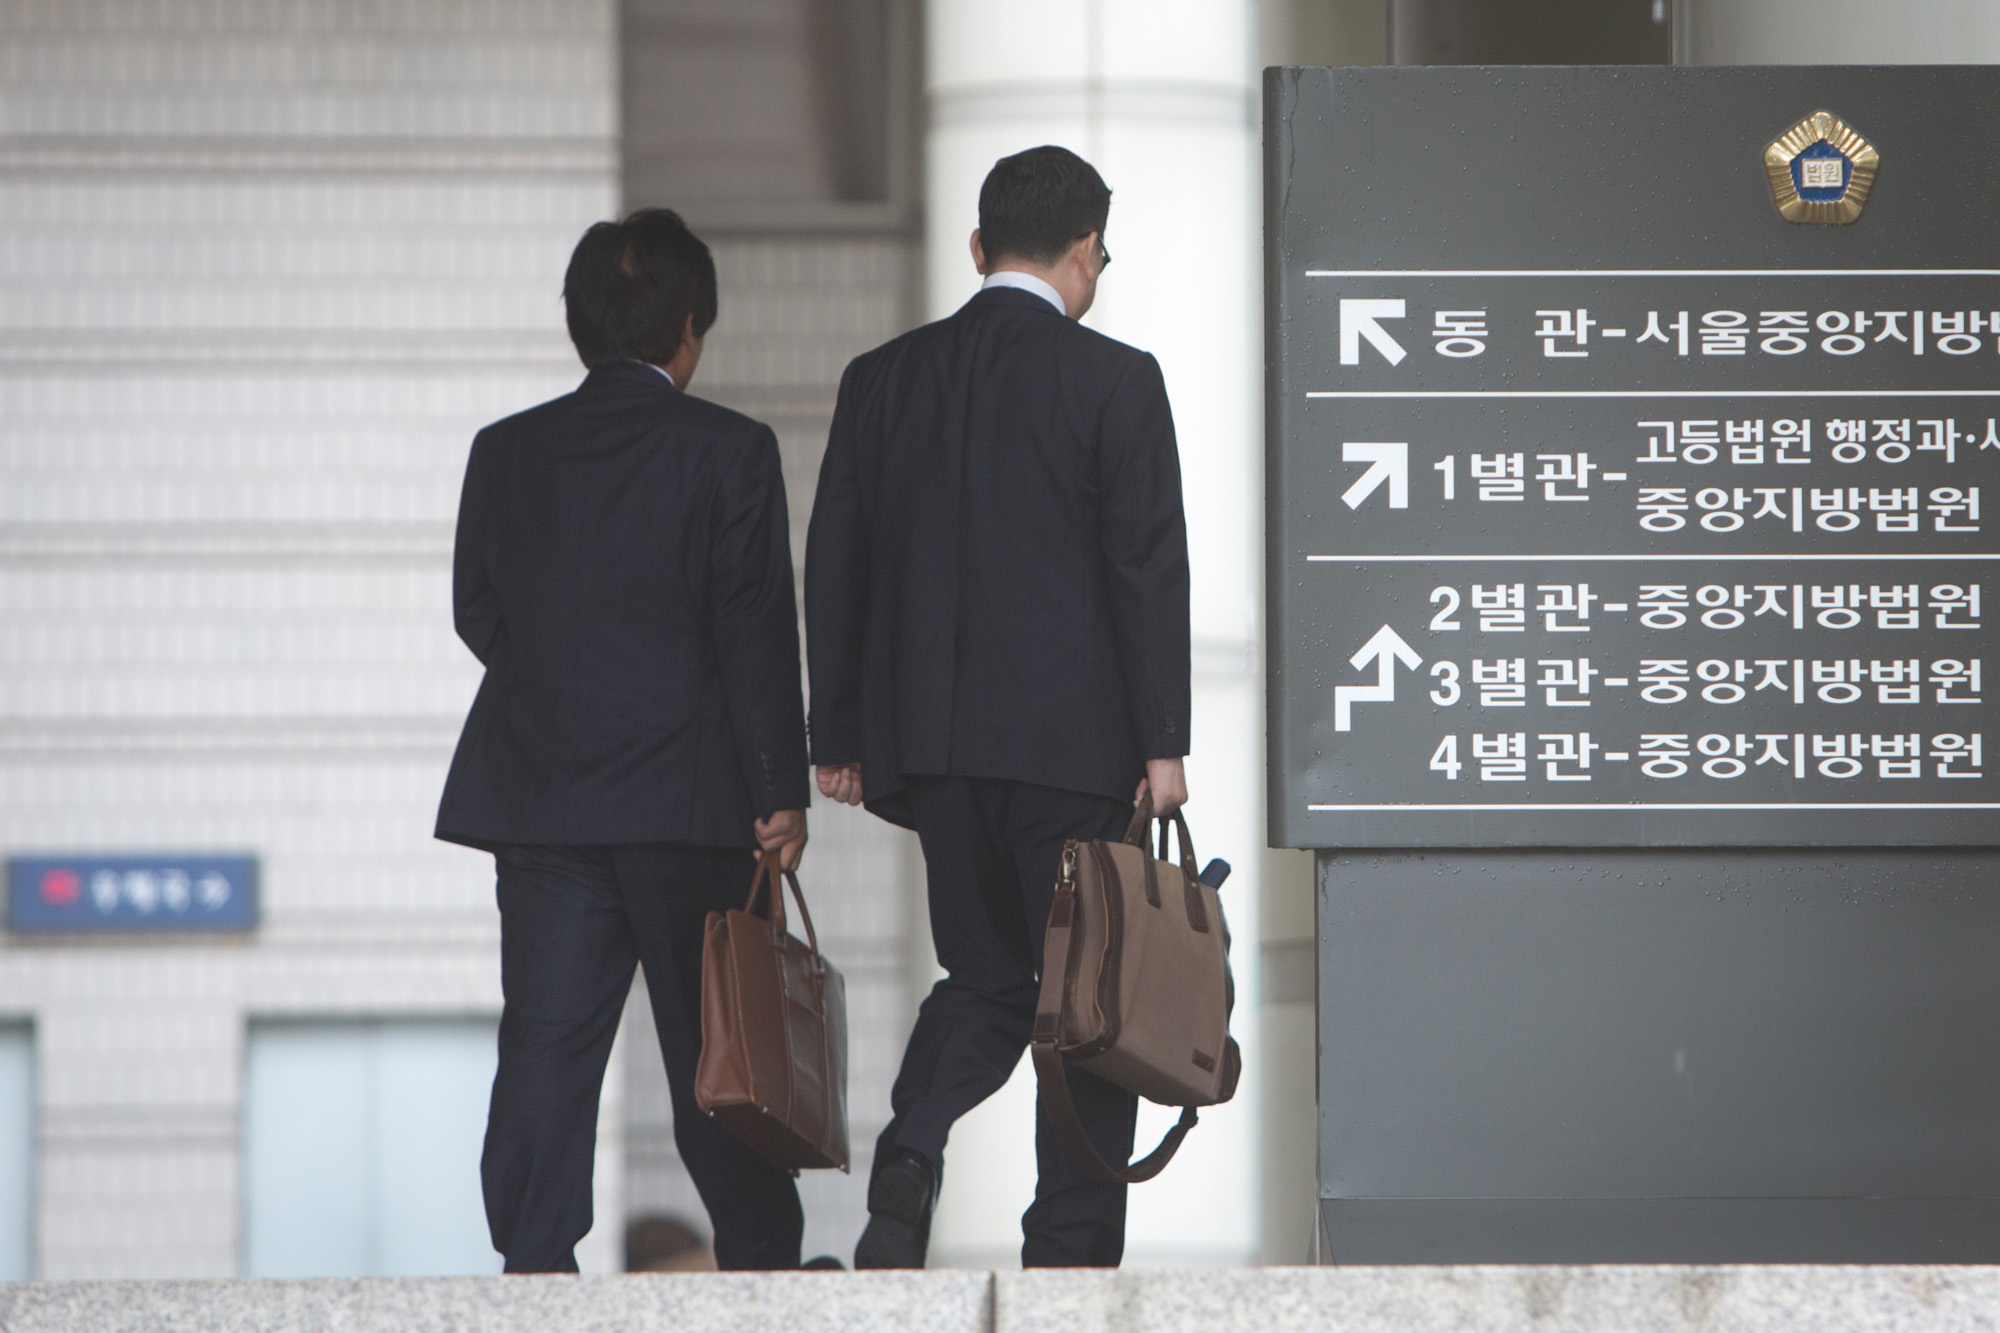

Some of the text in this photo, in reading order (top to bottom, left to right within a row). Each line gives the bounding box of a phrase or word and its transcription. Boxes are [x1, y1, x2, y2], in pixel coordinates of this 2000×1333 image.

[1432, 310, 1489, 358] 동
[1636, 419, 1812, 465] 고등법원
[1636, 488, 1980, 533] 중앙지방법원
